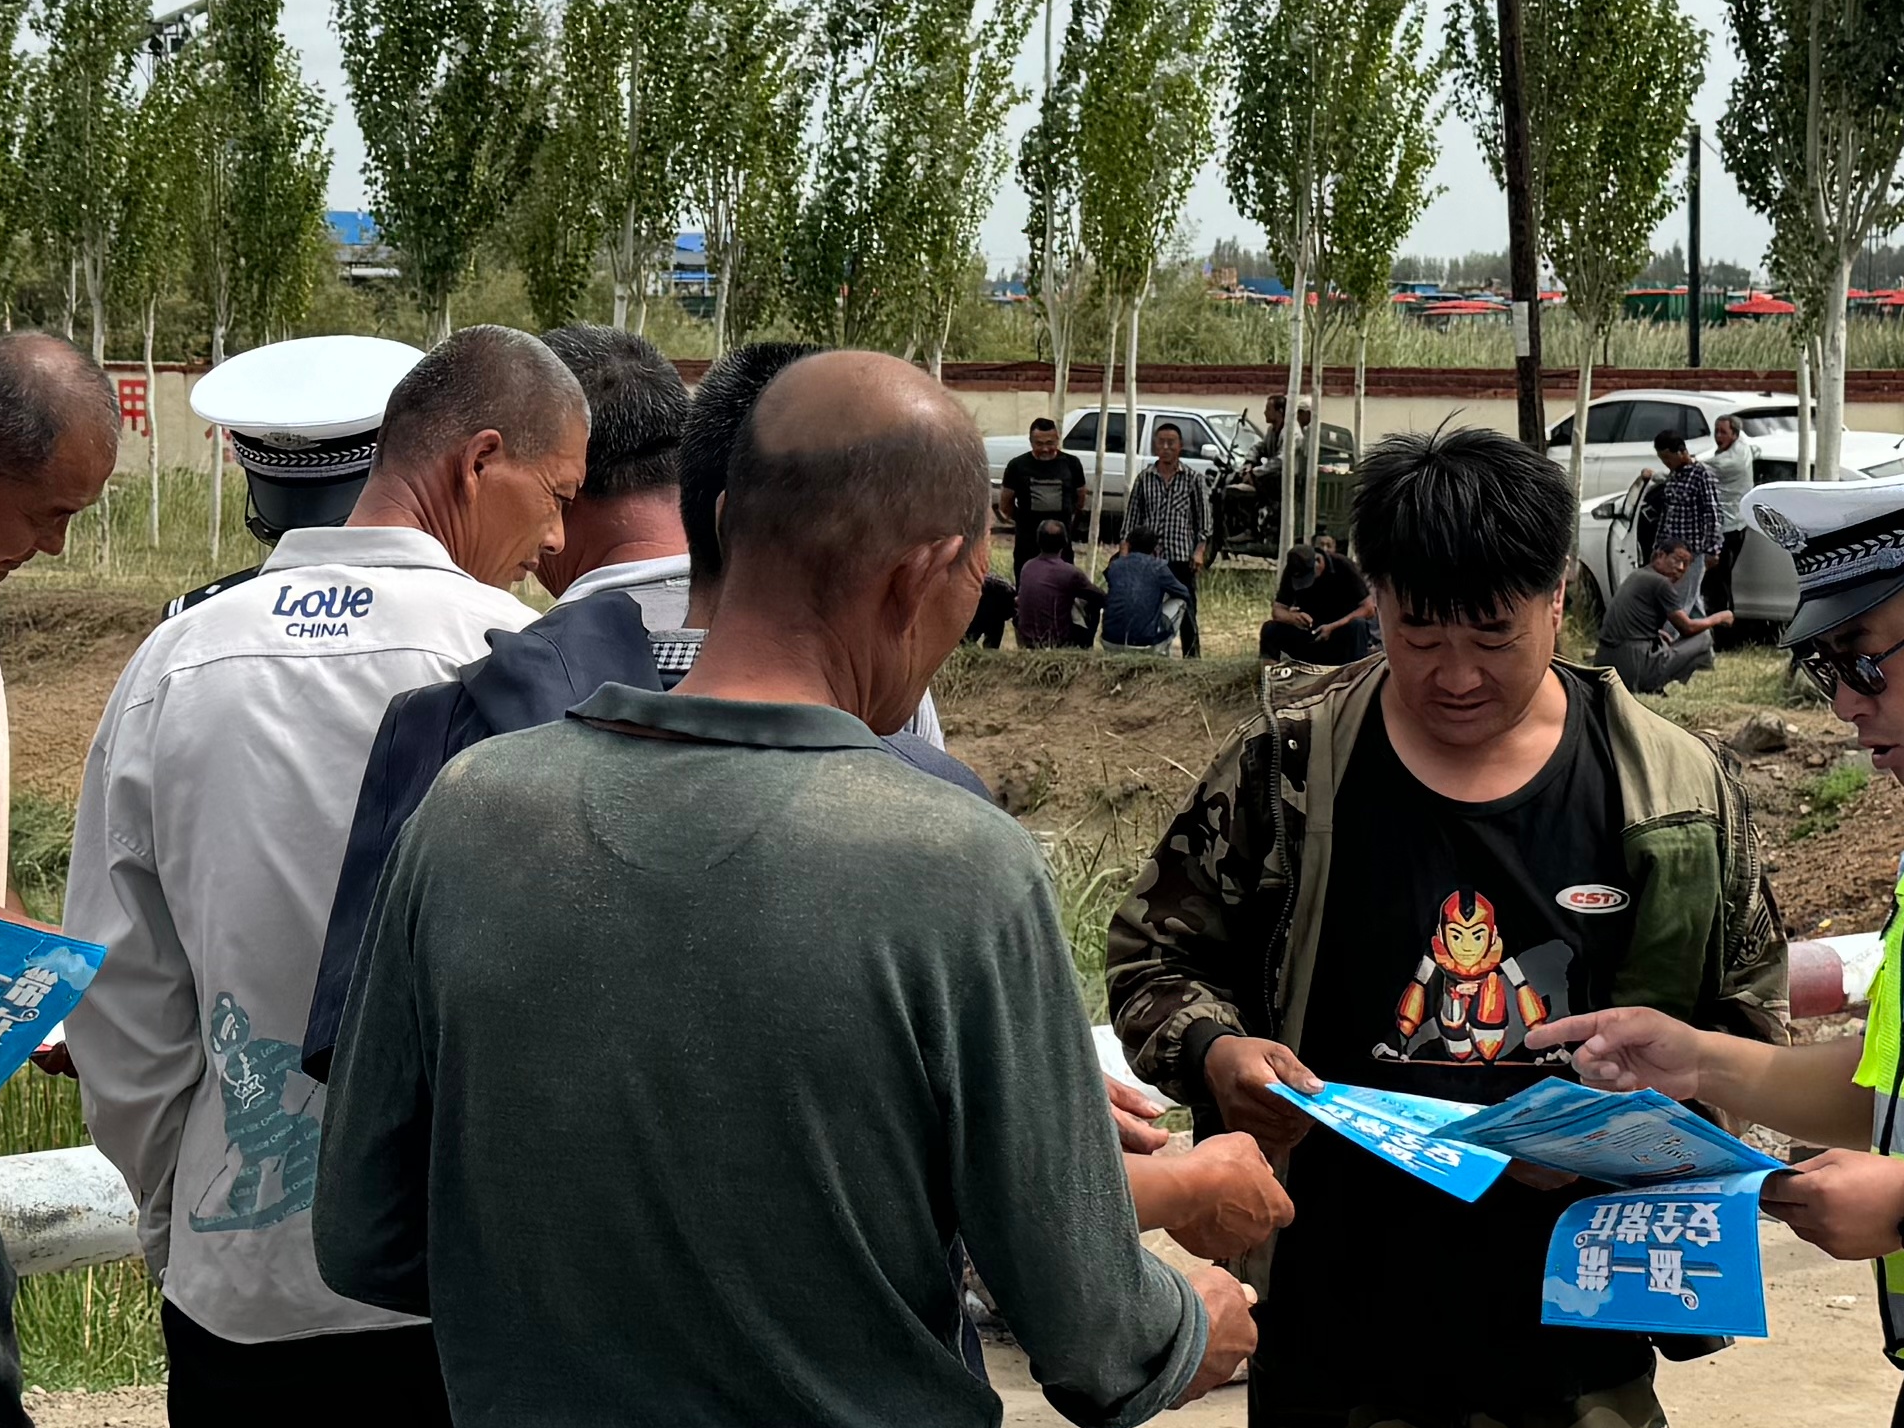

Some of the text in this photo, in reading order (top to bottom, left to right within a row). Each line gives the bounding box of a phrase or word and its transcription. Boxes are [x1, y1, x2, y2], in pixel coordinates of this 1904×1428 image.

[285, 622, 349, 638] CHINA
[1570, 891, 1614, 904] CST
[1573, 1201, 1723, 1248] 安全常在
